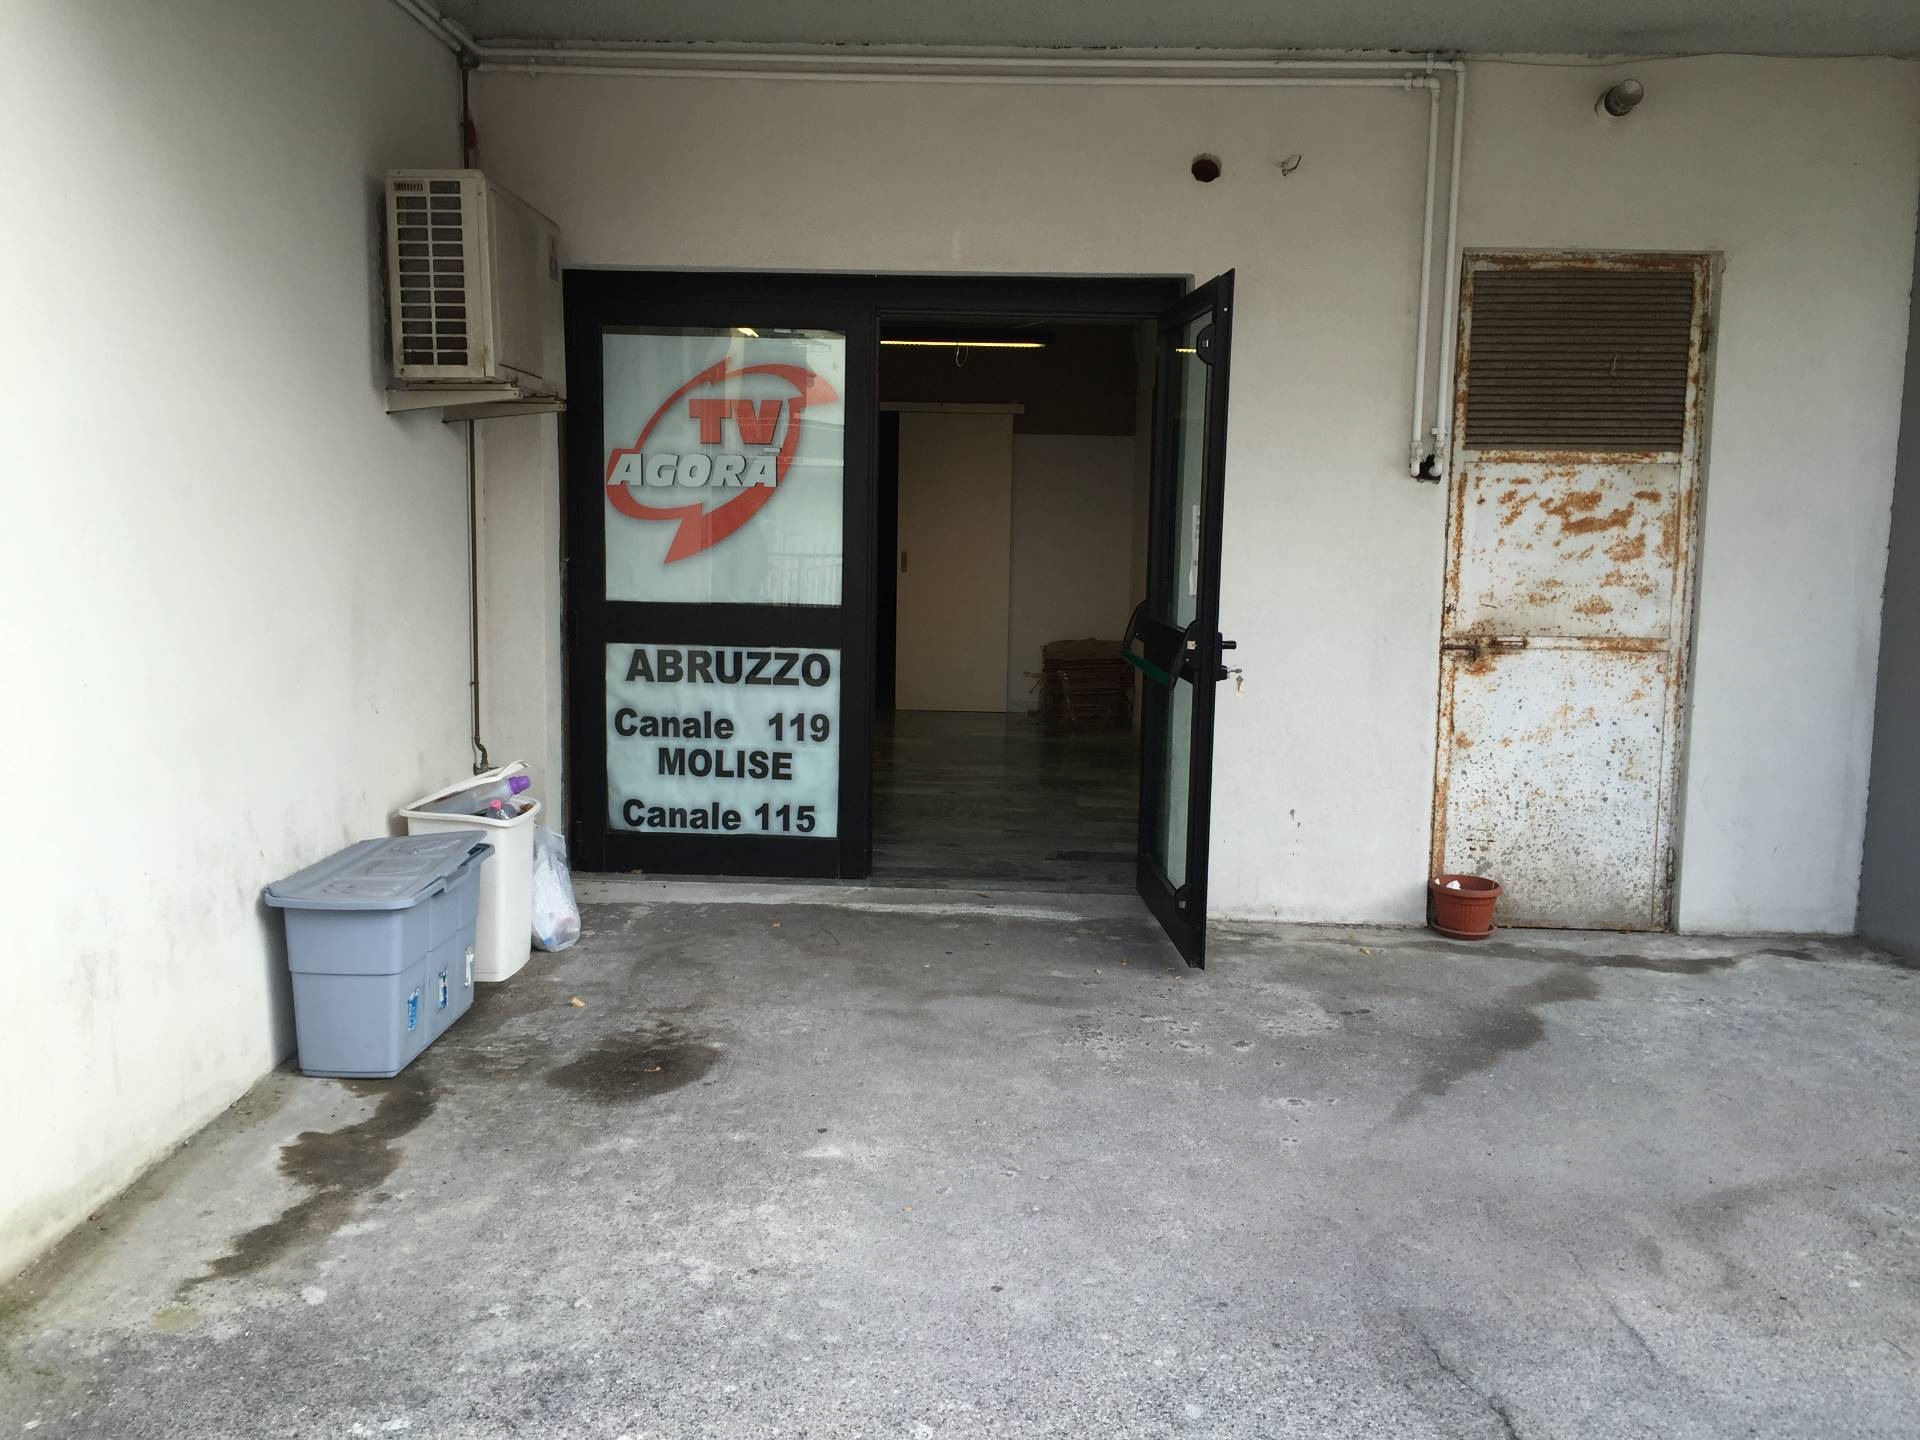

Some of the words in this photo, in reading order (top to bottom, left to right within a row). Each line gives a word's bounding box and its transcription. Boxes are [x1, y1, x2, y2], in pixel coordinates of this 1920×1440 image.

[689, 399, 783, 445] TV
[625, 649, 831, 687] ABRUZZO
[614, 707, 735, 740] Canale
[768, 712, 830, 742] 119
[657, 747, 793, 781] MOLISE
[622, 798, 742, 831] Canale
[754, 803, 816, 833] 115
